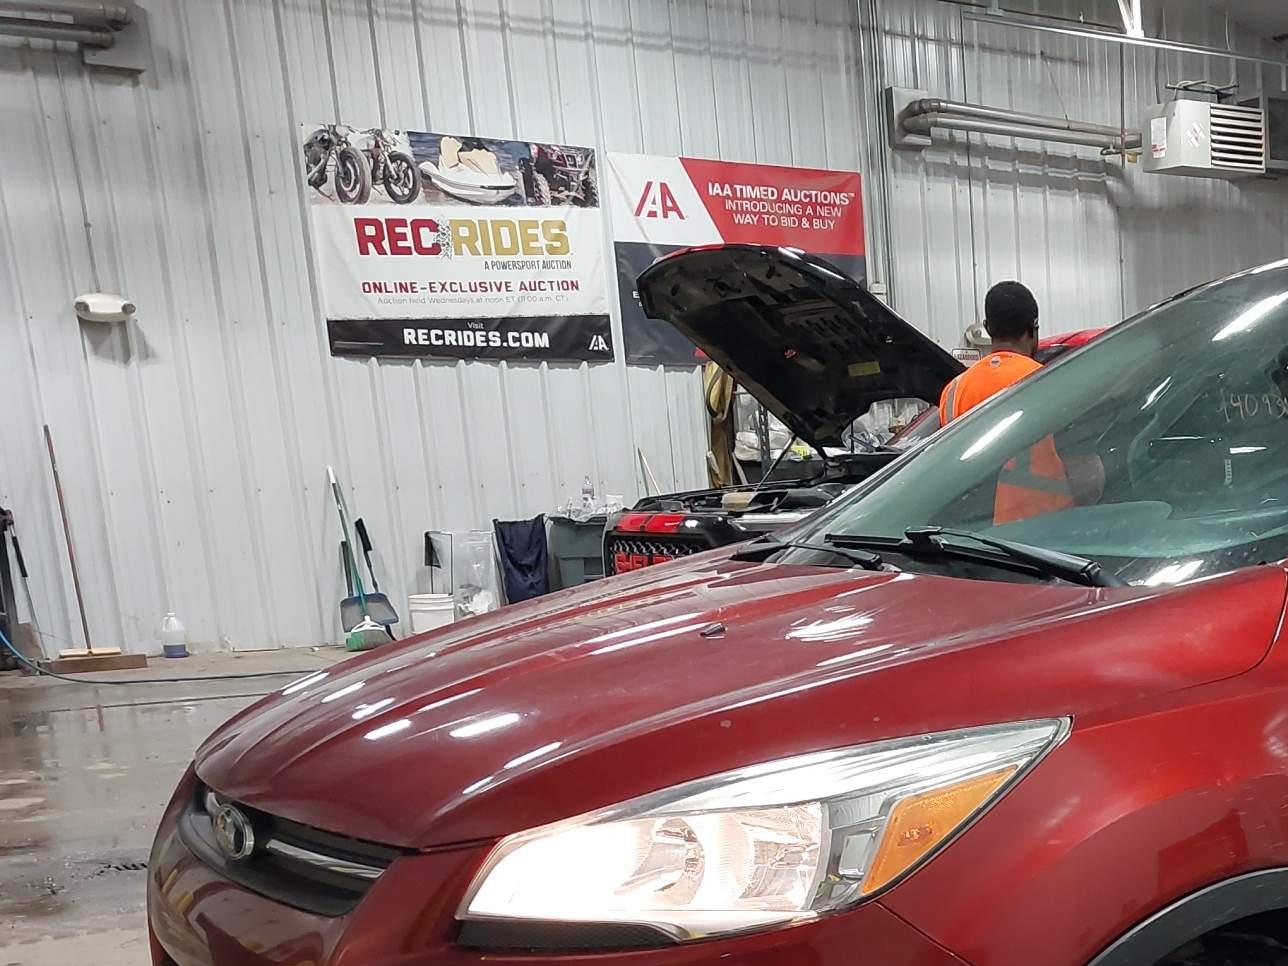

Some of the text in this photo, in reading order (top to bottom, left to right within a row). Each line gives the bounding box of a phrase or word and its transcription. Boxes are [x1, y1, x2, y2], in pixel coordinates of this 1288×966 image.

[709, 182, 733, 198] IAA
[734, 185, 778, 200] TIMED
[726, 199, 842, 217] INTRODUCING A NEW
[733, 214, 836, 230] WAY TO BID & BUY
[451, 219, 570, 256] RIDES
[484, 259, 572, 271] A POWERSPORT AUCTION
[362, 280, 579, 294] ONLINE-EXCLUSIVE AUCTION
[377, 297, 408, 305] Auction
[467, 321, 484, 330] Visit
[403, 328, 550, 348] RECRIDES.COM
